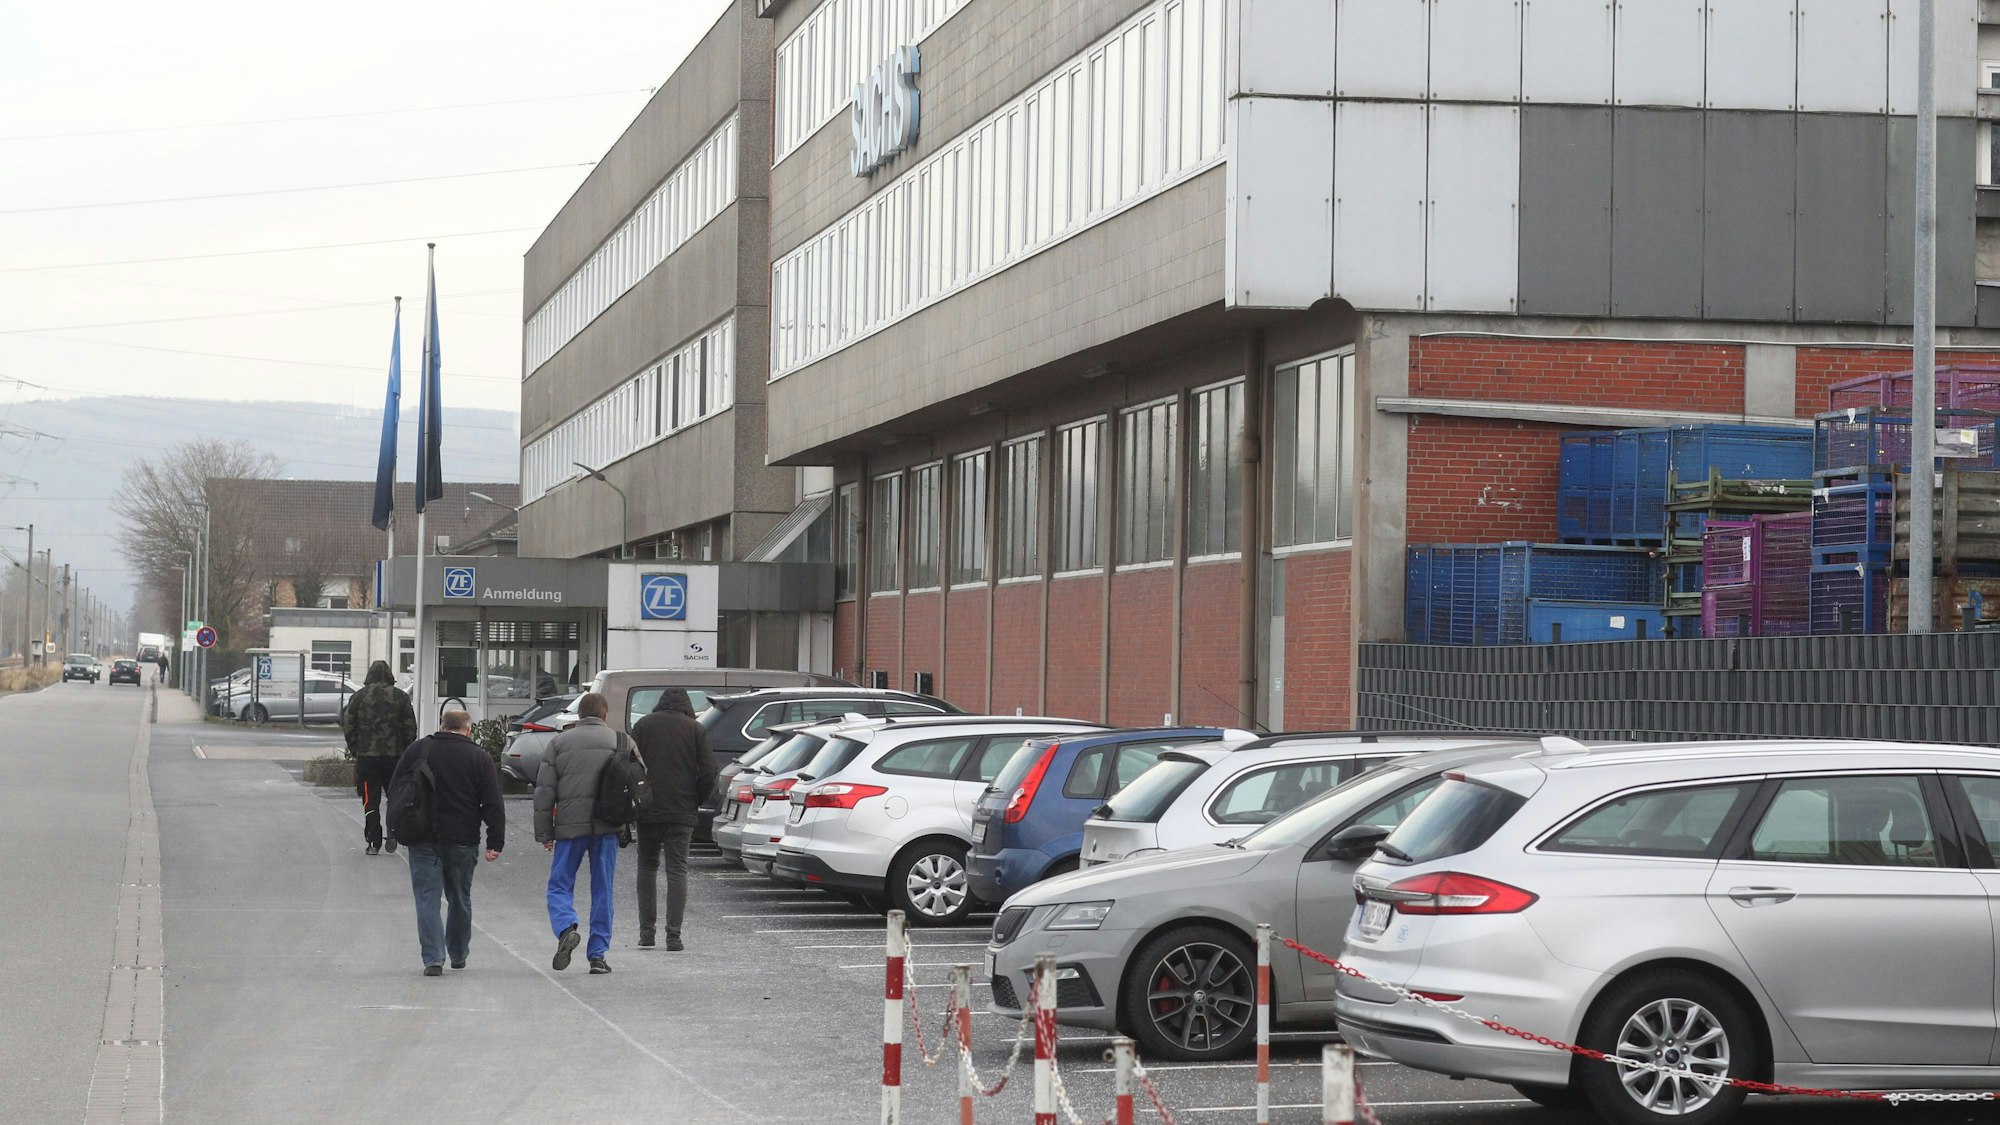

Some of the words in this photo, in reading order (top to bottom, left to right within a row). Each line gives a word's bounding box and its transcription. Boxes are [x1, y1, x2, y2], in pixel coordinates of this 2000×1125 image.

[851, 46, 919, 178] SACHS
[447, 574, 472, 591] ZF
[483, 587, 562, 603] Anmeldung
[646, 584, 682, 609] ZF
